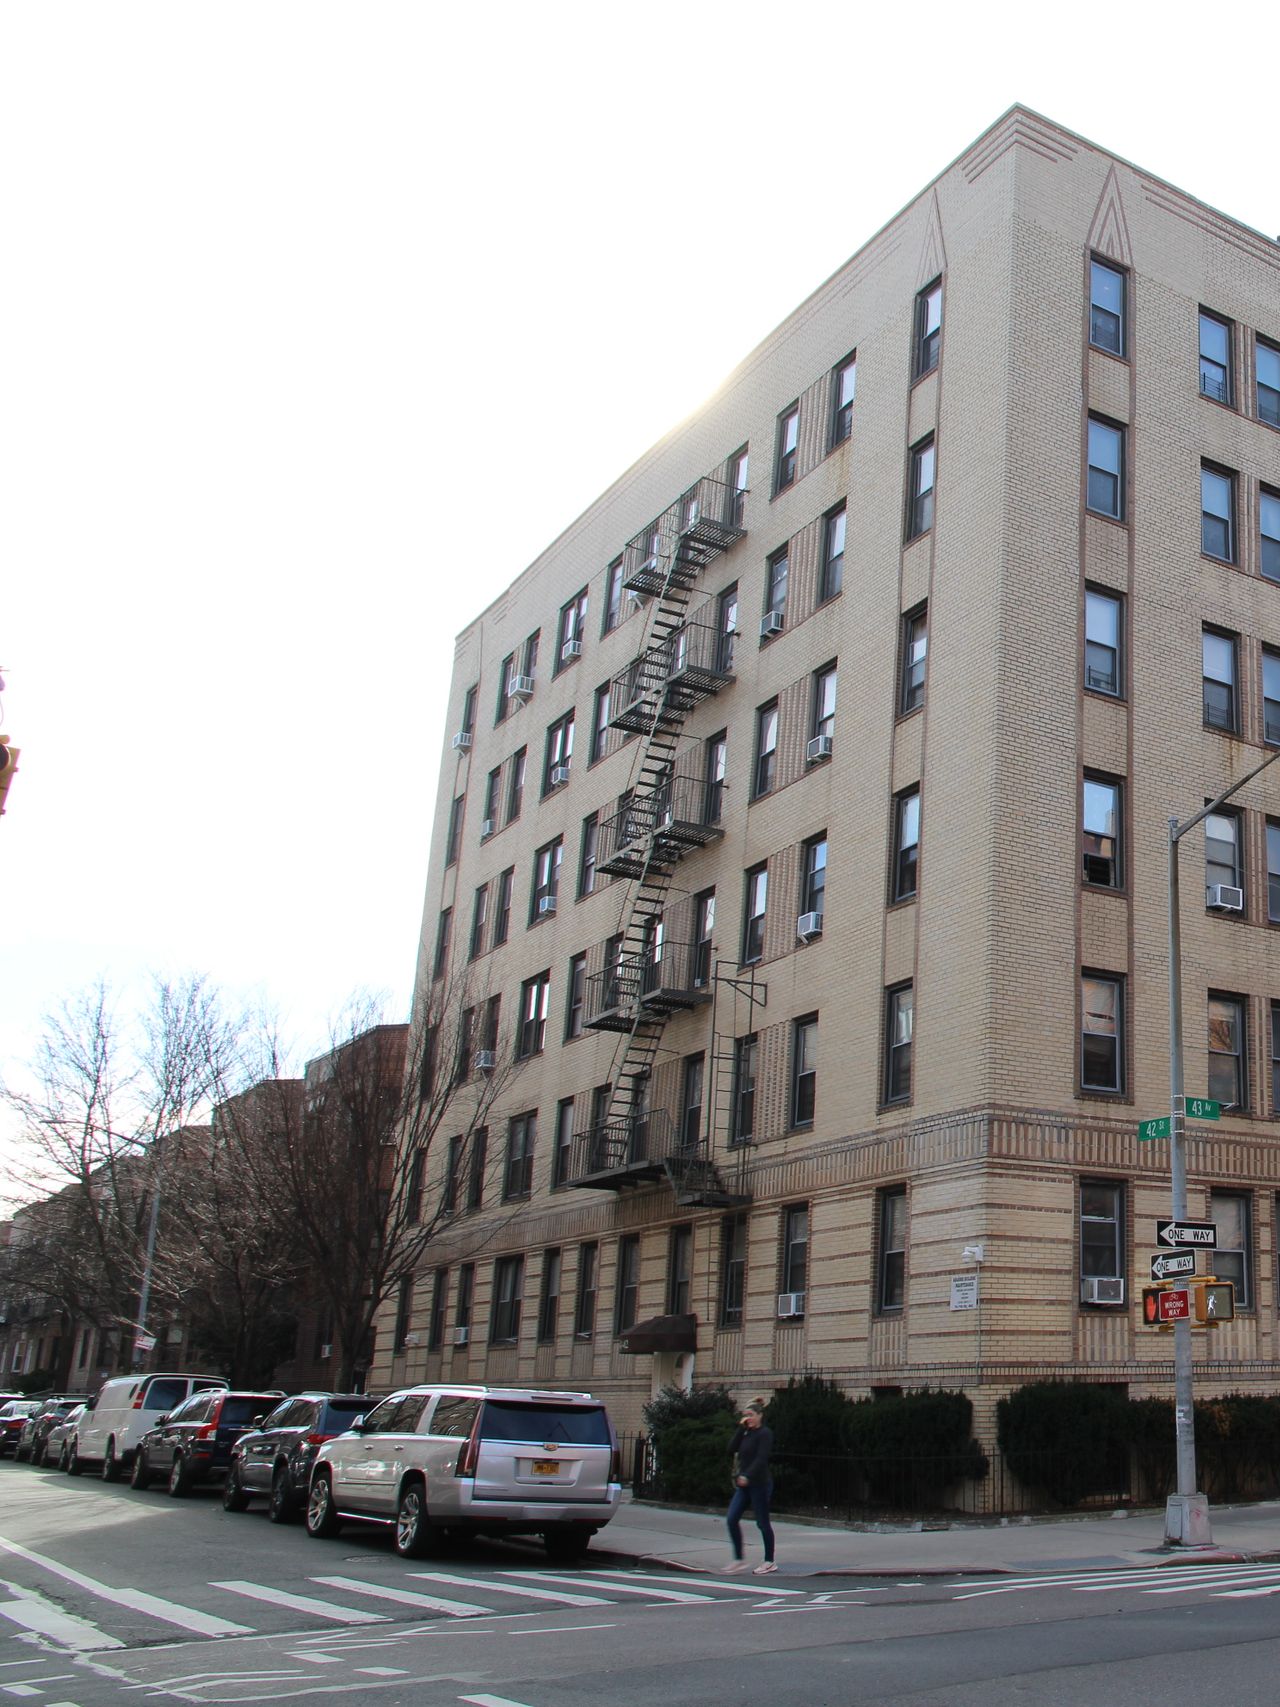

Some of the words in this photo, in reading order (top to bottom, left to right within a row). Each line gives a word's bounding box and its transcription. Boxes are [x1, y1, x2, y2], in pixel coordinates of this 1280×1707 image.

[1192, 1101, 1202, 1116] 43
[1146, 1121, 1156, 1137] 42
[1168, 1228, 1185, 1240] ONE
[1192, 1230, 1210, 1241] WAY
[1156, 1260, 1170, 1273] ONE
[1176, 1257, 1192, 1270] WAY
[1165, 1301, 1184, 1309] WRONG
